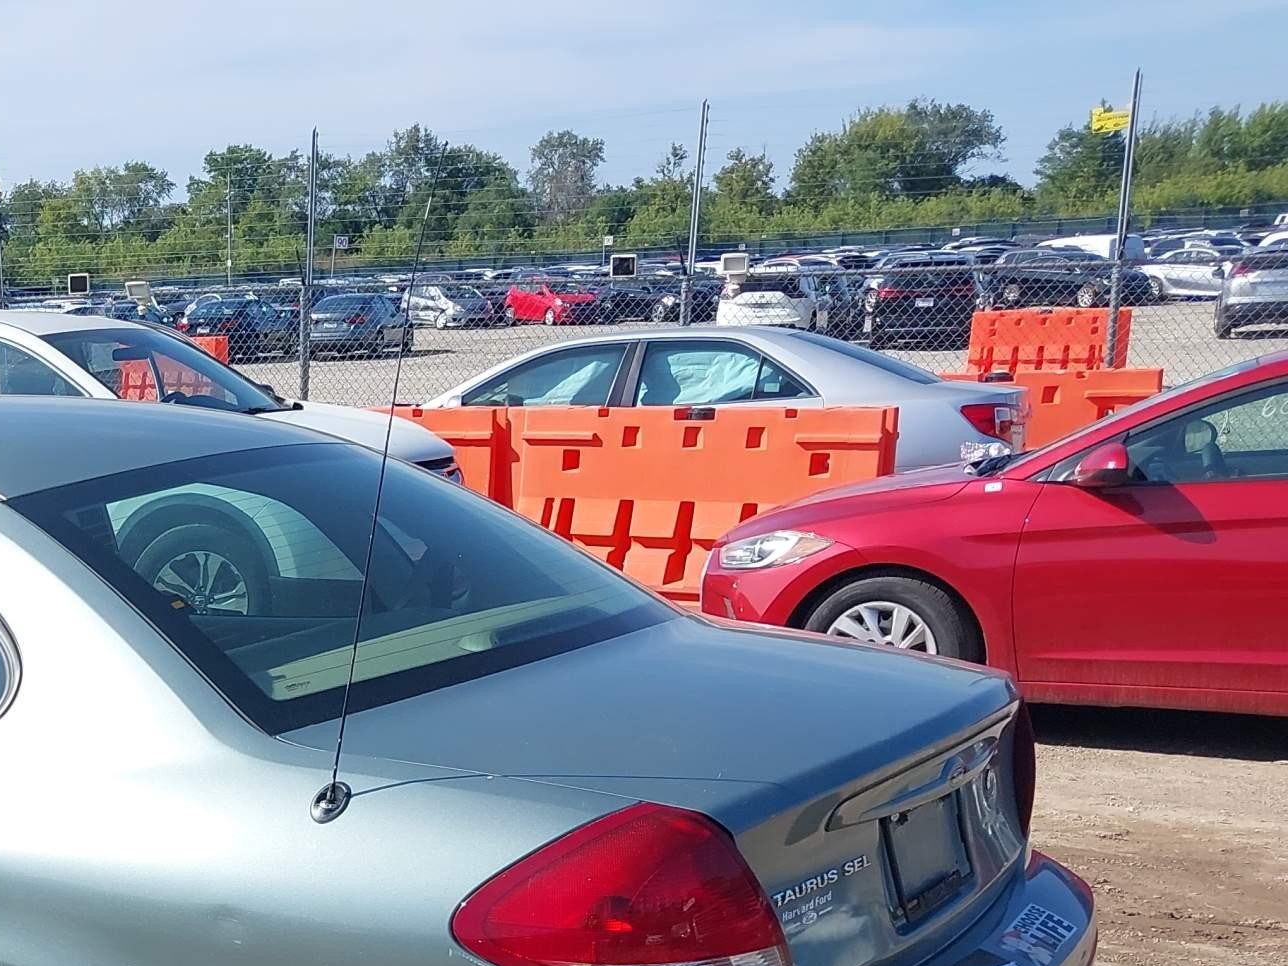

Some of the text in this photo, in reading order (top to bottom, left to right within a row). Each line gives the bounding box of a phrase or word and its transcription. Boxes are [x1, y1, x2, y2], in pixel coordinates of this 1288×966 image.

[773, 855, 872, 907] TAURUS SEL
[782, 899, 814, 922] Harvard
[815, 890, 832, 907] Ford
[1013, 905, 1047, 935] CHOOSE
[1029, 912, 1075, 951] LIFE
